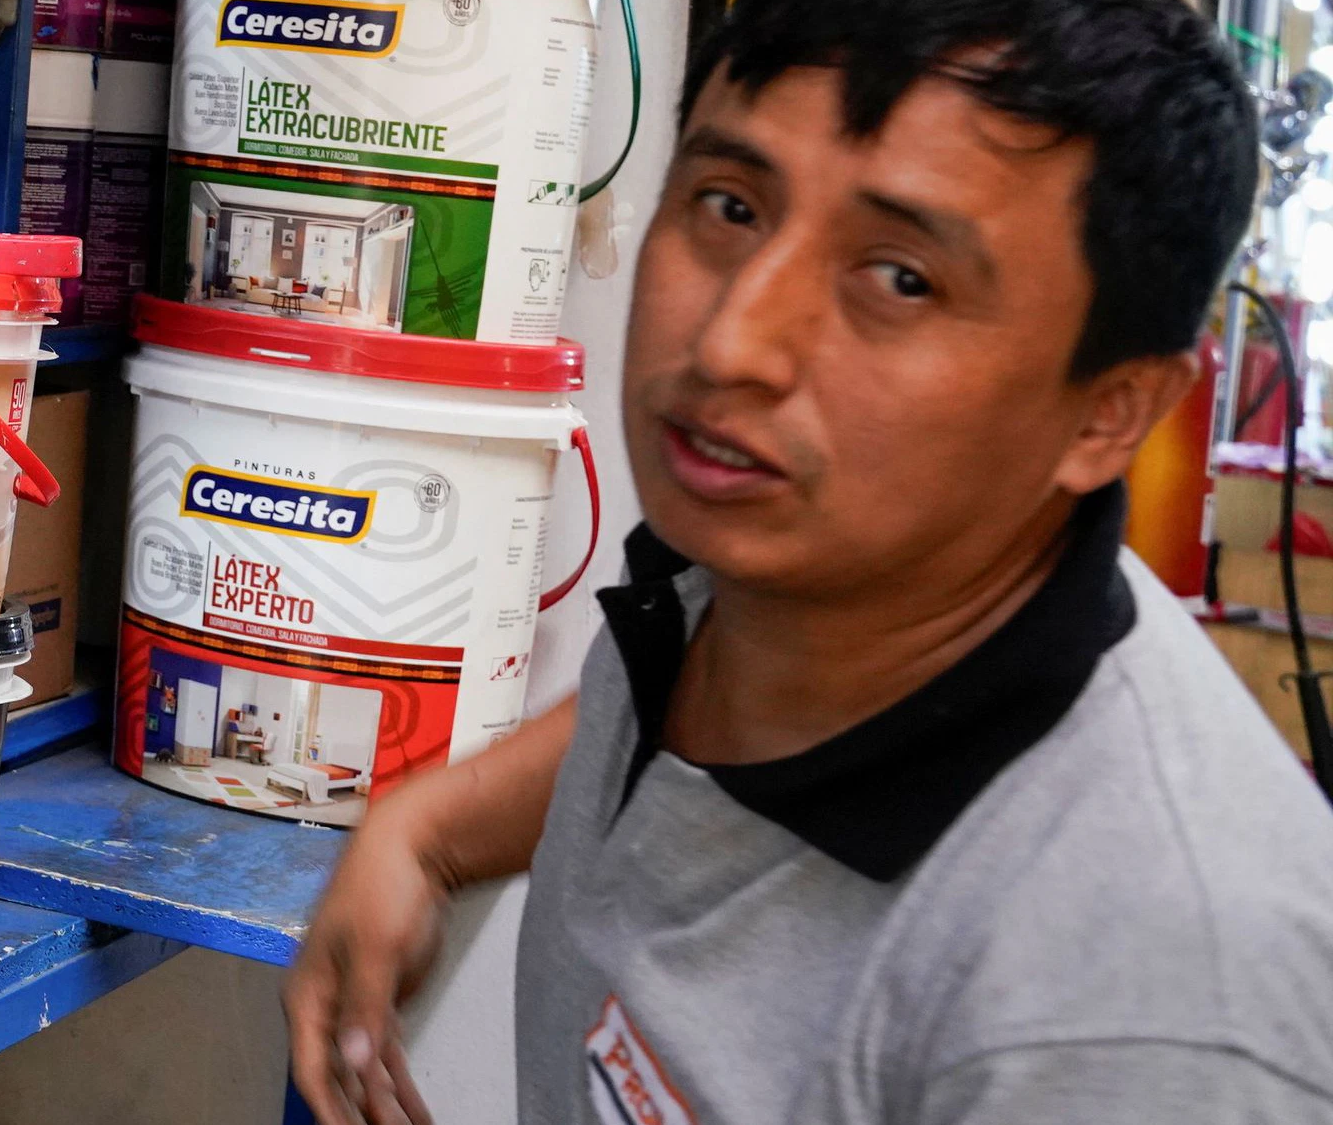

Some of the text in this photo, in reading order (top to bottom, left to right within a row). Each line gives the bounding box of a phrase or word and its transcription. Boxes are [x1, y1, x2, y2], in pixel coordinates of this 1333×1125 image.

[226, 5, 385, 47] Ceresita
[247, 76, 311, 110] LÁTEX
[246, 107, 448, 153] EXTRACUBRIENTE
[234, 459, 317, 480] PINTURAS
[191, 478, 357, 534] Ceresita
[214, 554, 281, 592] LÁTEX
[211, 583, 315, 625] EXPERTO
